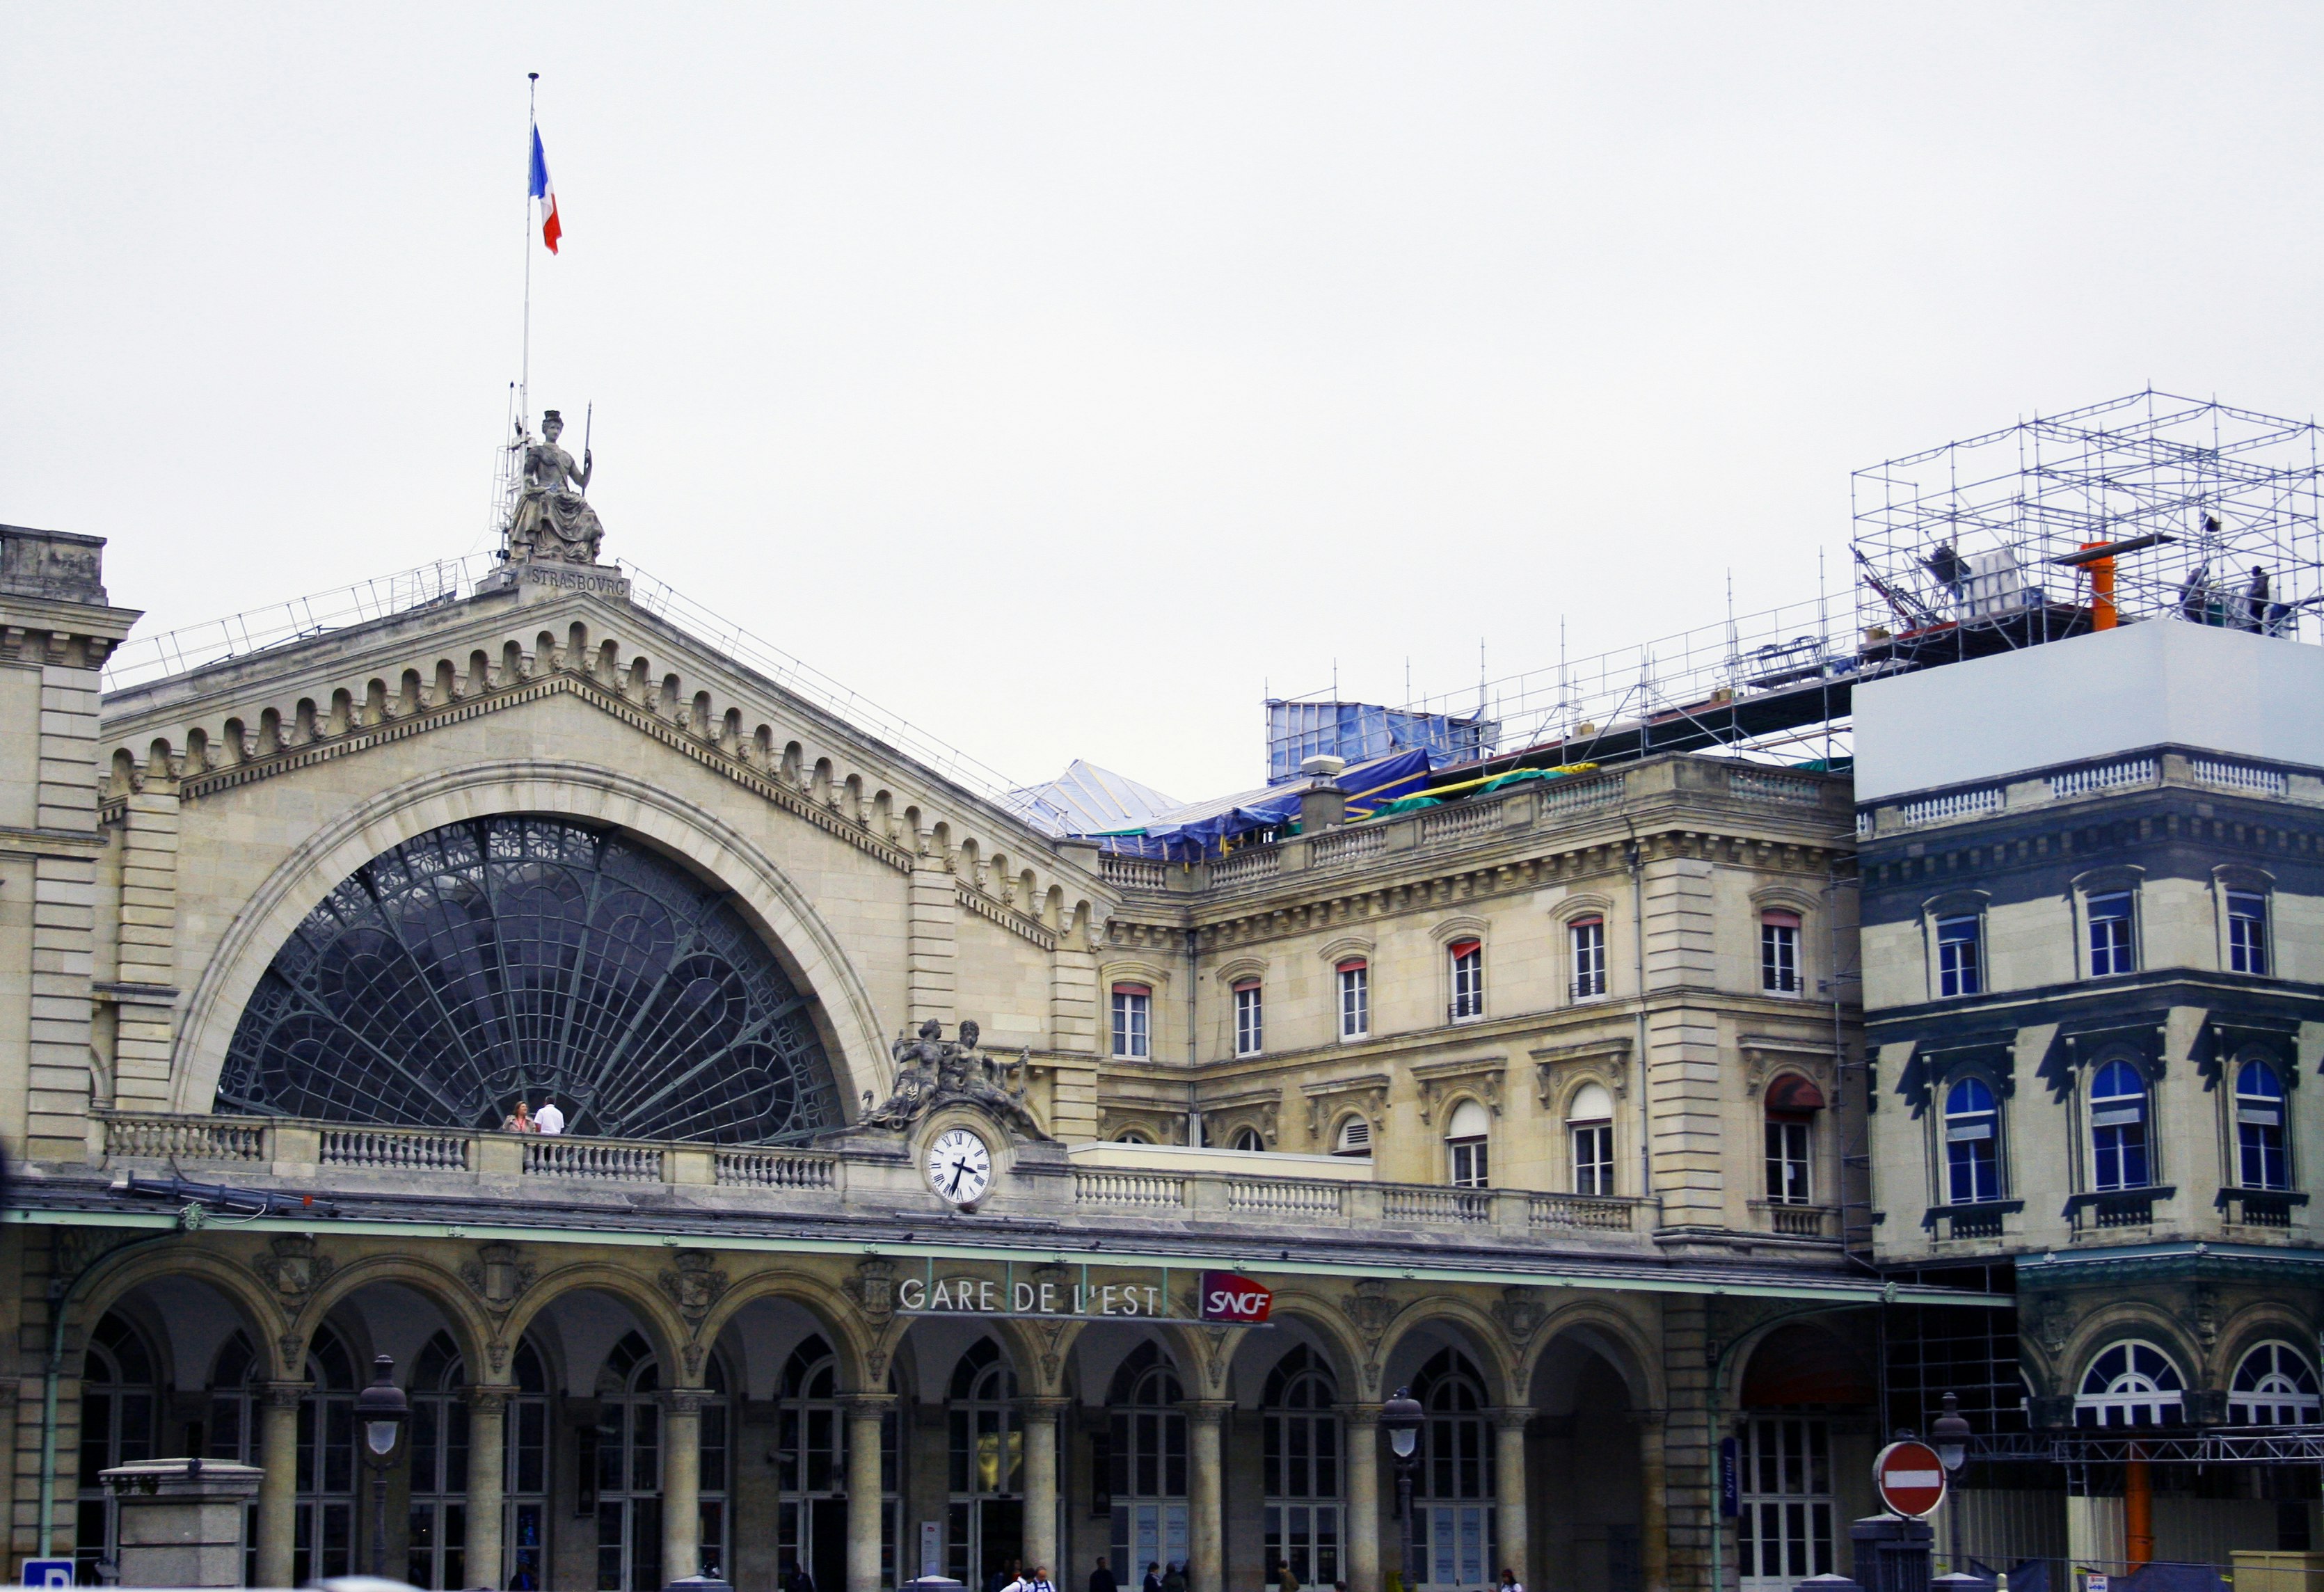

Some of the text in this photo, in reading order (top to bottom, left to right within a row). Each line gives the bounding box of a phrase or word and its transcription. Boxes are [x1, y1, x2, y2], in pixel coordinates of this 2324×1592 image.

[532, 568, 625, 596] STRASBOVRG
[900, 1278, 1159, 1315] GARE DE L'EST
[1206, 1291, 1269, 1314] SNCF
[1724, 1456, 1734, 1498] Kyriad
